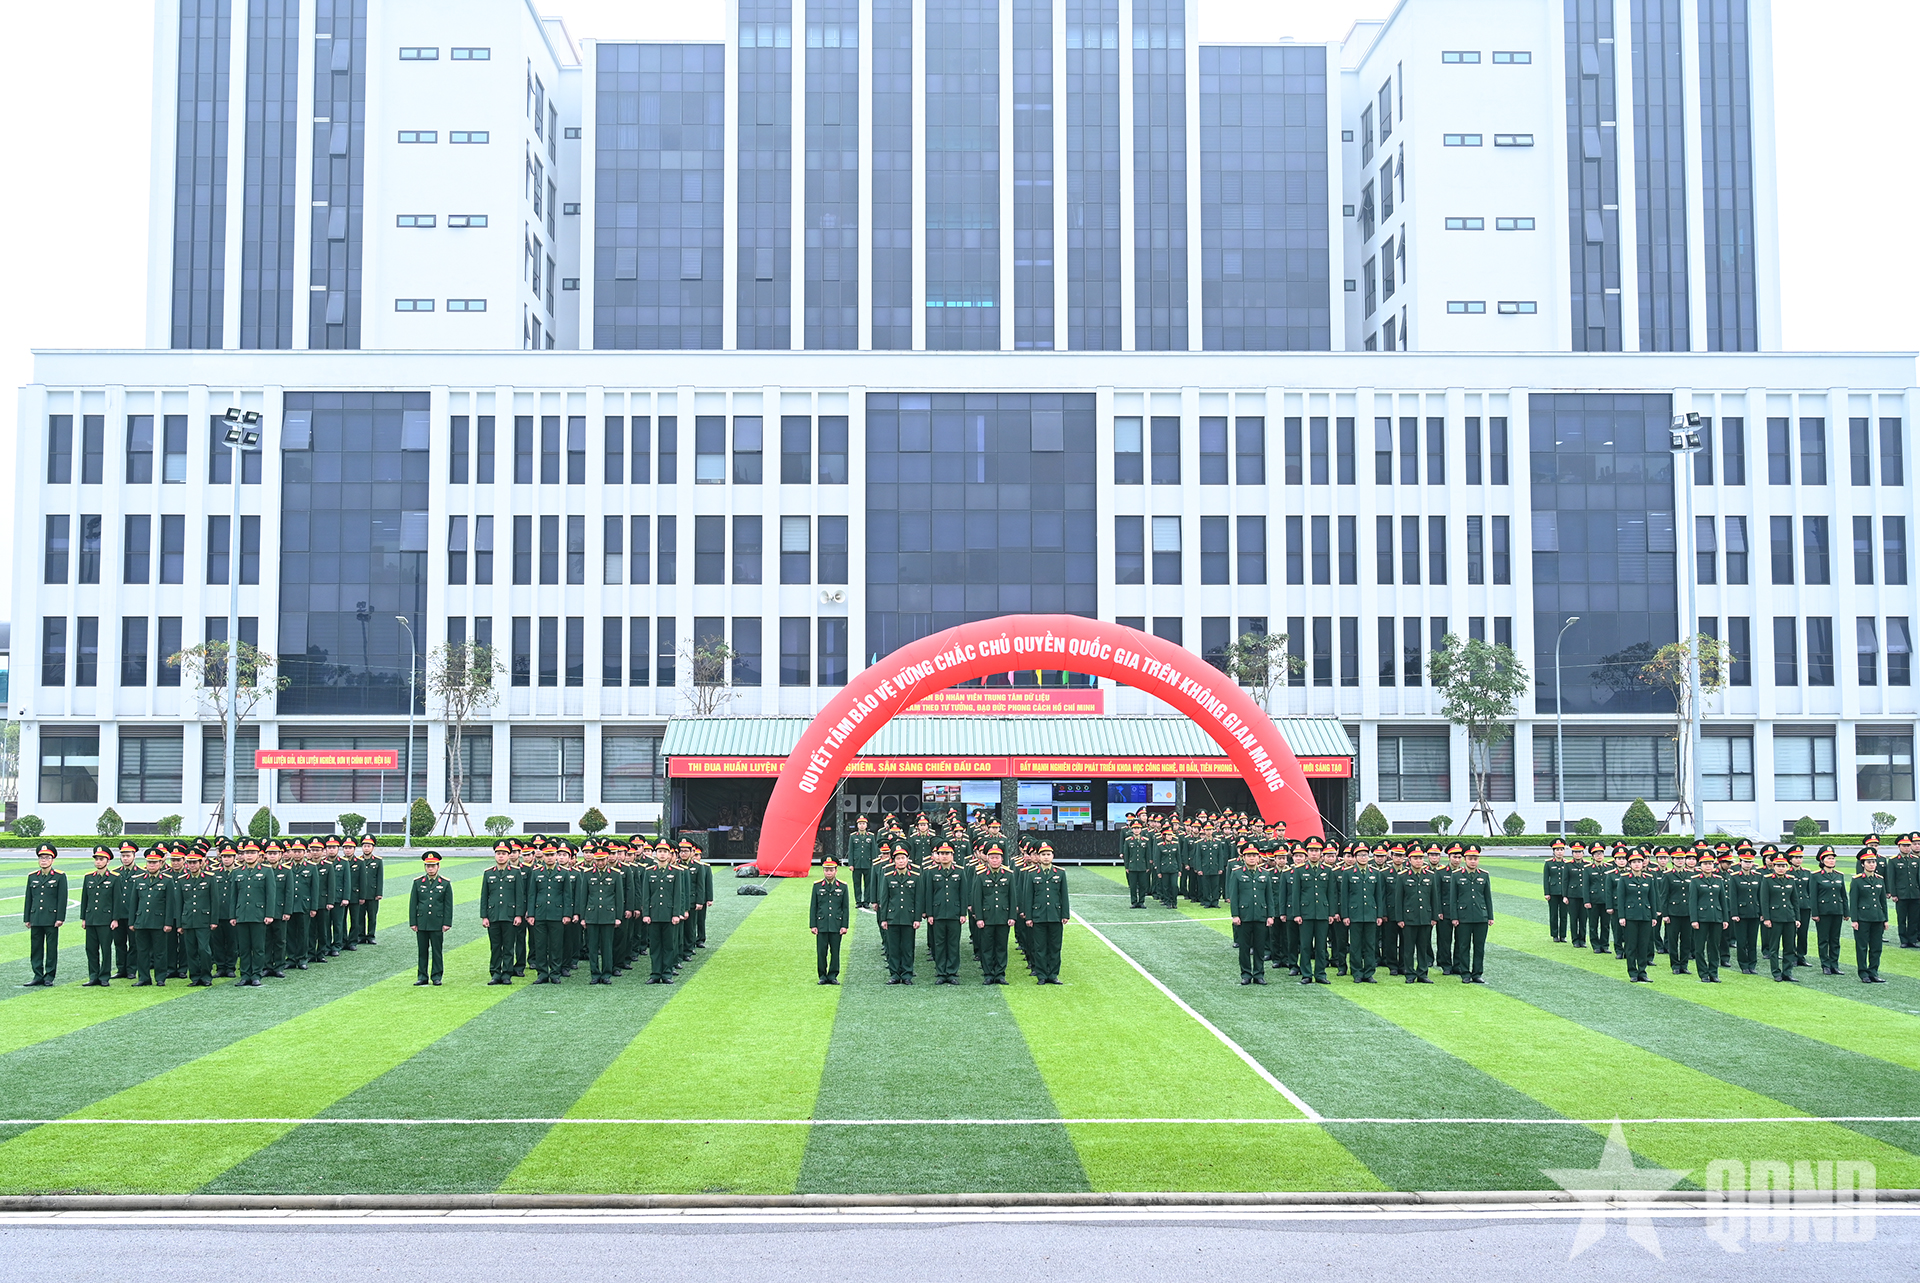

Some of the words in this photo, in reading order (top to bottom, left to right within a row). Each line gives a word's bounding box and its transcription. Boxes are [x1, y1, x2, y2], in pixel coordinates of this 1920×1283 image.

[935, 693, 944, 702] BỘ
[946, 693, 965, 701] NHÂN
[966, 693, 983, 701] VIÊN
[1008, 693, 1023, 701] TÂM
[1035, 693, 1050, 702] LIỆU
[798, 746, 833, 793] QUYẾT
[824, 717, 857, 750] TÂM
[848, 697, 879, 724] BẢO
[873, 679, 897, 701] VỆ
[892, 659, 935, 691] VỮNG
[934, 642, 976, 671] CHẮC
[978, 632, 1010, 657] CHỦ
[1013, 631, 1065, 654] QUYỀN
[1068, 636, 1111, 660] QUỐC
[1113, 648, 1140, 670] GIA
[1141, 657, 1181, 687] TRÊN
[1178, 676, 1228, 720] KHÔNG
[1223, 712, 1258, 750] GIAN
[1248, 745, 1285, 793] MẠNG
[922, 704, 939, 712] THEO
[941, 704, 950, 712] TƯ
[977, 704, 991, 713] ĐẠO
[1033, 703, 1051, 711] CÁCH
[1063, 703, 1075, 711] CHÍ
[274, 755, 287, 766] LUYỆN
[306, 755, 318, 766] LUYỆN
[844, 761, 876, 772] GHIÊM,
[900, 761, 923, 772] SÀNG
[925, 760, 952, 772] CHIẾN
[953, 760, 972, 772] ĐẤU
[973, 763, 991, 772] CAO
[688, 763, 701, 772] THI
[704, 763, 721, 772] ĐUA
[724, 760, 748, 772] HUẤN
[750, 762, 777, 773] LUYỆN
[1032, 763, 1049, 773] MẠNH
[1050, 762, 1070, 772] NGHIÊN
[1084, 762, 1098, 772] PHÁT
[1117, 764, 1131, 772] KHOA
[1133, 763, 1144, 773] HỌC
[1145, 762, 1160, 772] CÔNG
[1200, 762, 1213, 772] TIÊN
[1214, 764, 1232, 772] PHONG
[1303, 762, 1314, 772] MỚI
[1315, 762, 1330, 772] SÁNG
[1332, 763, 1342, 773] TẠO
